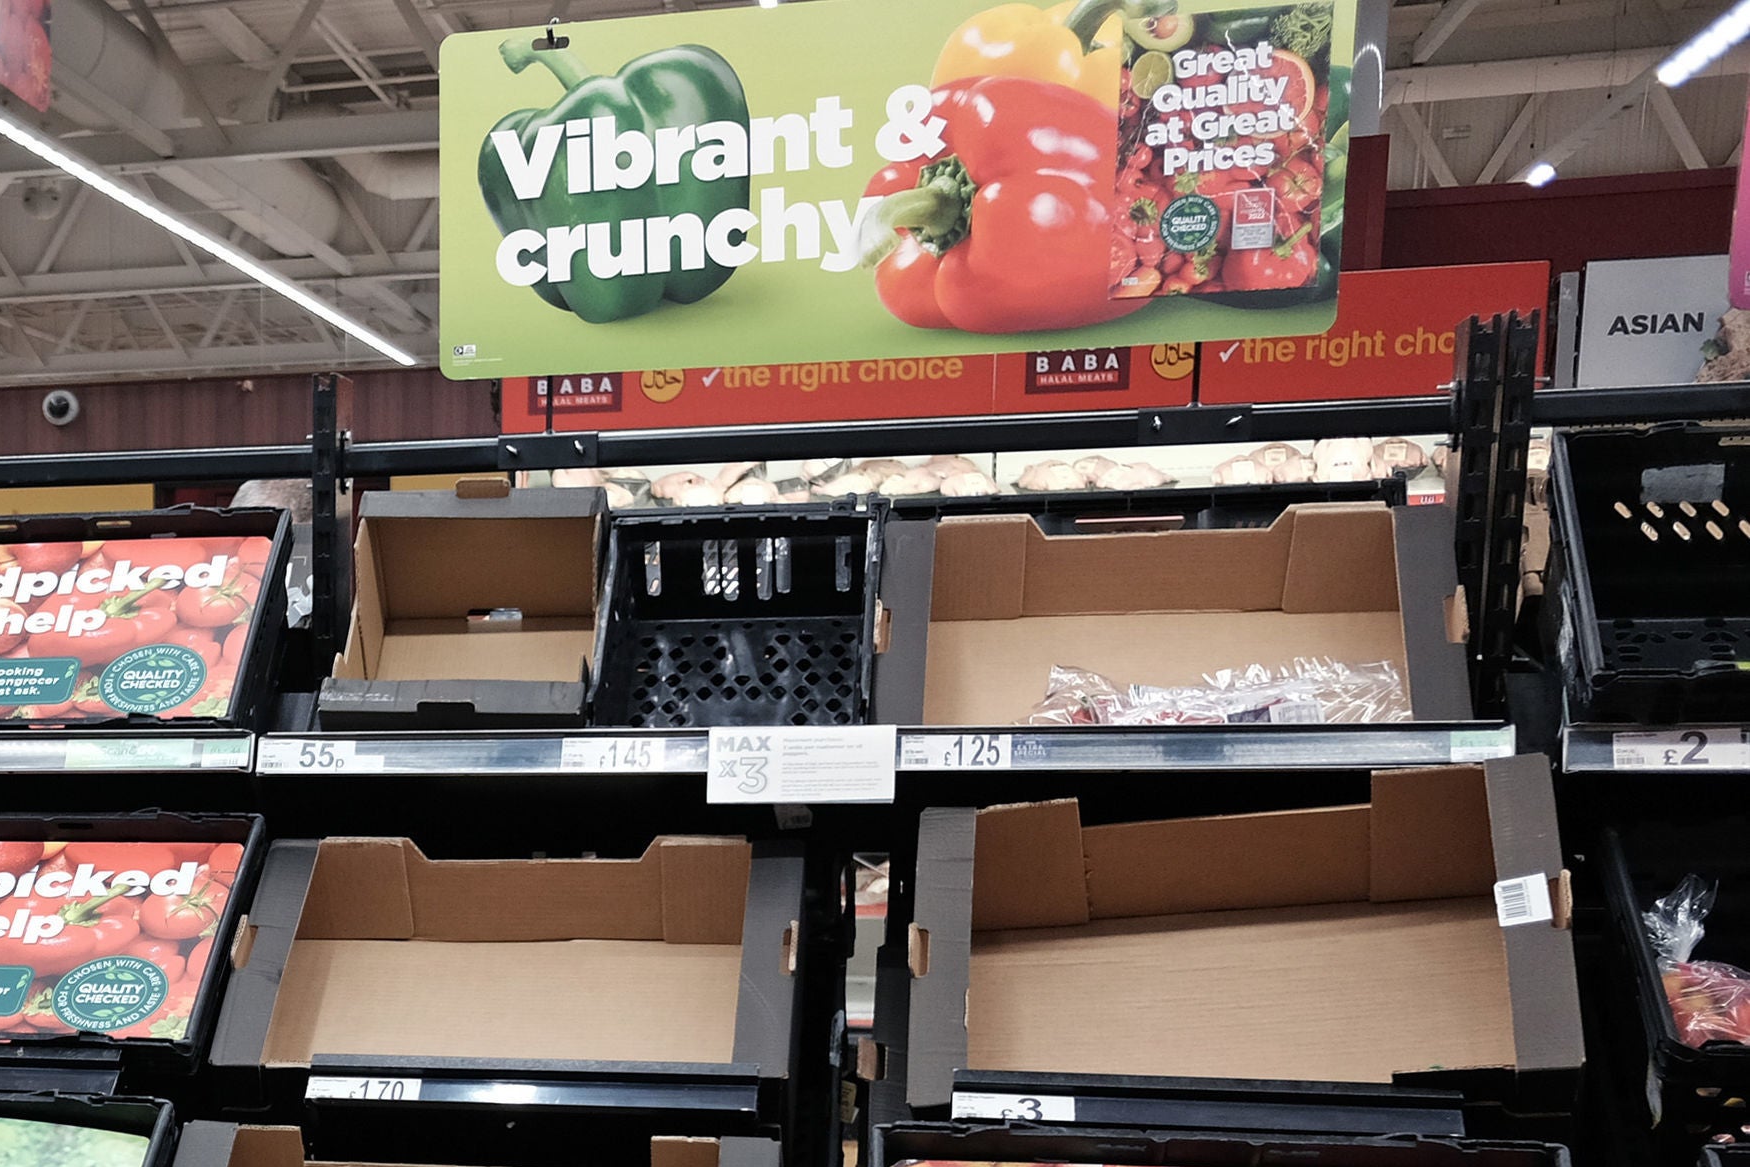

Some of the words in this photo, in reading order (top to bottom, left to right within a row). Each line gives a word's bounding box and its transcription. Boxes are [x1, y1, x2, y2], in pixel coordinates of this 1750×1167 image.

[1173, 41, 1273, 79] Great
[1152, 75, 1288, 113] Quality
[1145, 116, 1186, 147] at
[1191, 103, 1296, 141] Great
[491, 95, 853, 201] Vibrant
[875, 84, 948, 162] &
[1164, 141, 1275, 176] Prices
[1171, 224, 1207, 232] CHECKED
[1172, 215, 1207, 224] QUALITY
[495, 187, 886, 287] crunchy
[1607, 312, 1704, 336] ASIAN
[1241, 334, 1296, 365] the
[1304, 328, 1387, 369] right
[1036, 353, 1119, 373] BABA
[723, 366, 771, 389] the
[778, 361, 850, 392] right
[859, 357, 963, 383] choice
[1040, 374, 1074, 384] HALAL
[1078, 373, 1114, 382] MEATS
[120, 680, 180, 689] CHECKED
[123, 669, 183, 680] QUALITY
[717, 736, 771, 752] MAX
[1663, 731, 1709, 765] £2
[300, 743, 345, 772] 55p
[67, 960, 111, 984] CHOSEN
[116, 960, 142, 969] WITH
[142, 967, 161, 986] CARE
[58, 991, 68, 1007] FOR
[75, 994, 140, 1004] CHECKED
[79, 983, 144, 994] QUALITY
[139, 993, 161, 1013] TASTE
[61, 1007, 111, 1029] FRESHNESS
[115, 1013, 140, 1026] AND
[1001, 1097, 1043, 1120] £3
